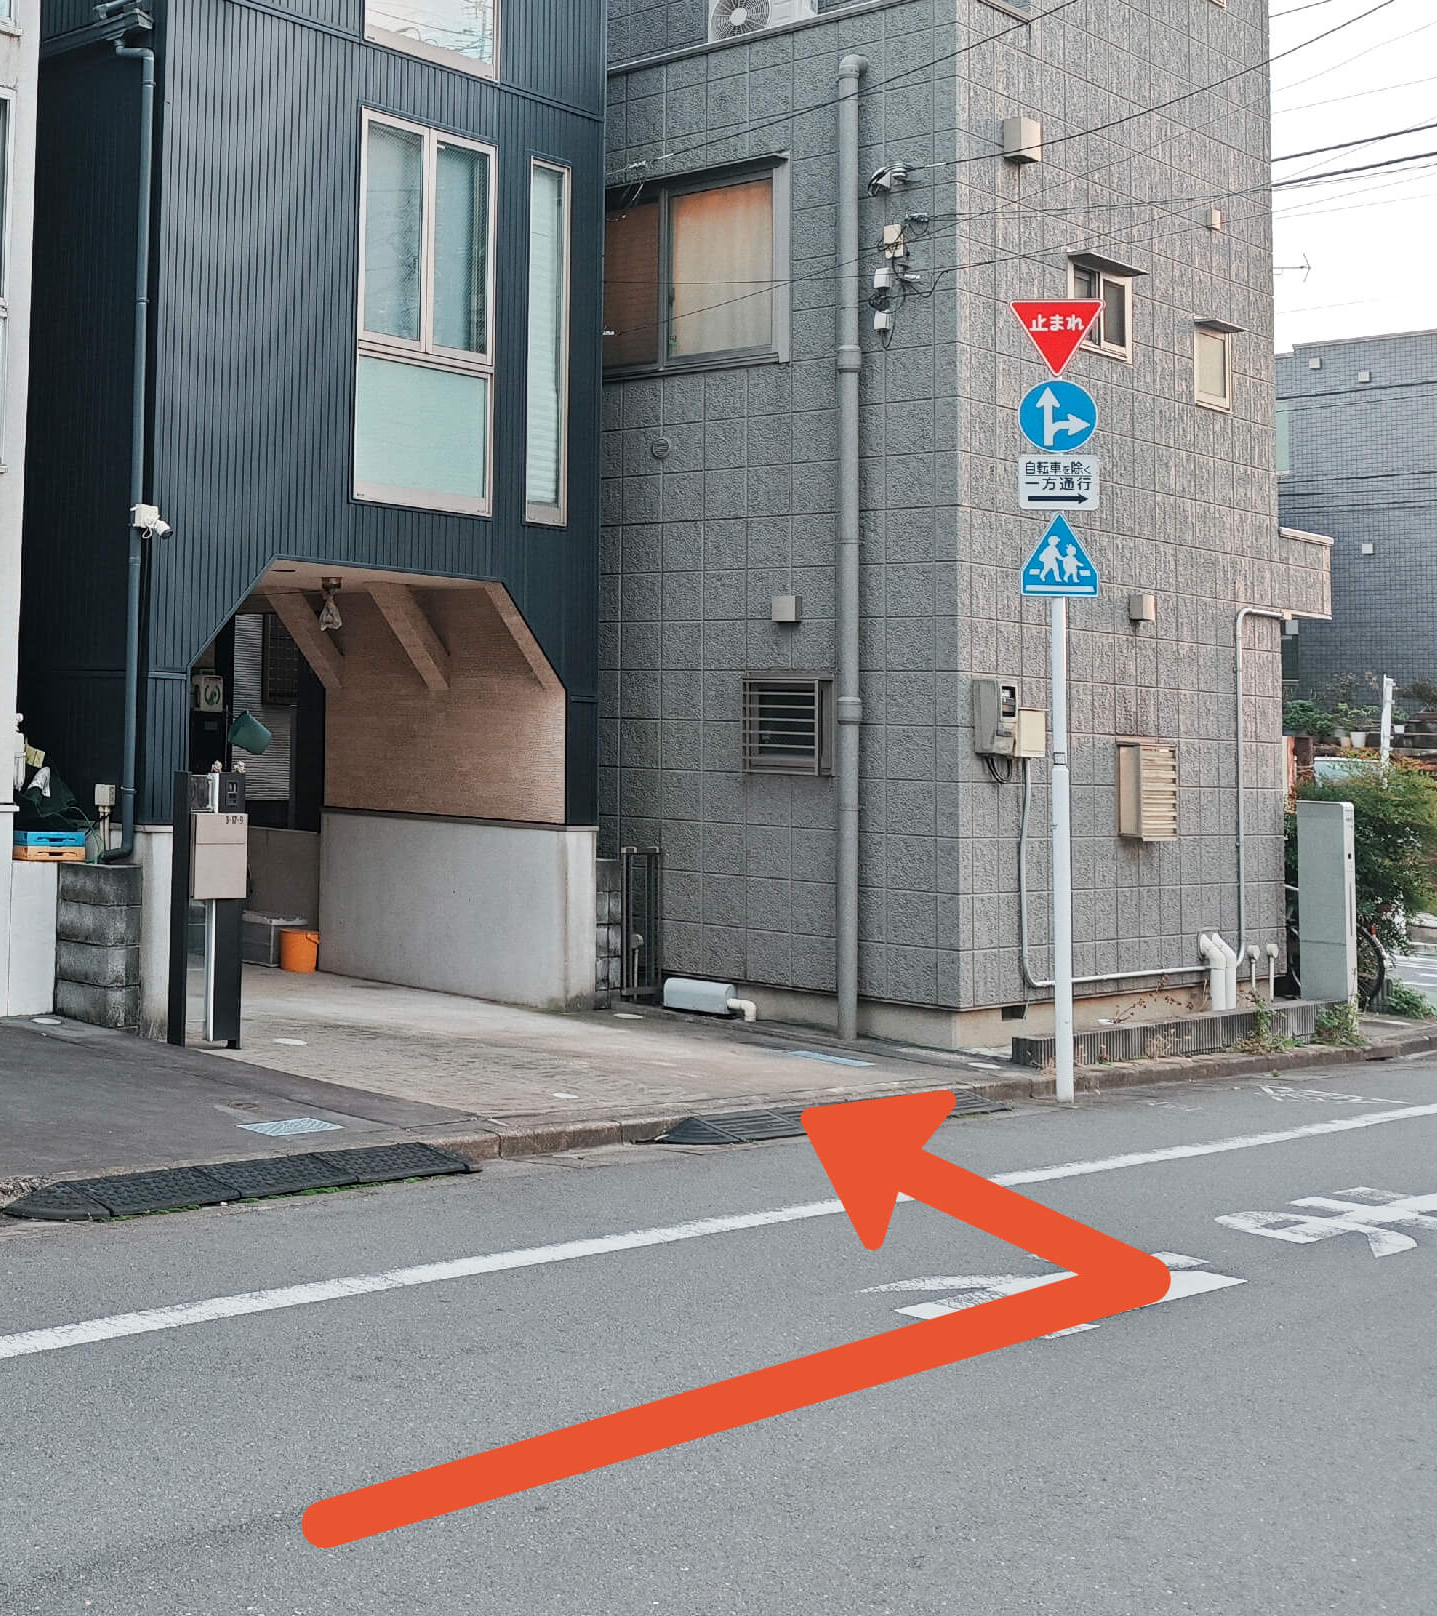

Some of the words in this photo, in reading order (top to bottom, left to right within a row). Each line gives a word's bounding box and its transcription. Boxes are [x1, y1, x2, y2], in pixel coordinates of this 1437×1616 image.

[1029, 314, 1085, 332] 止まれ
[1025, 460, 1091, 475] 自転車を除く
[1025, 477, 1092, 491] 一方通行
